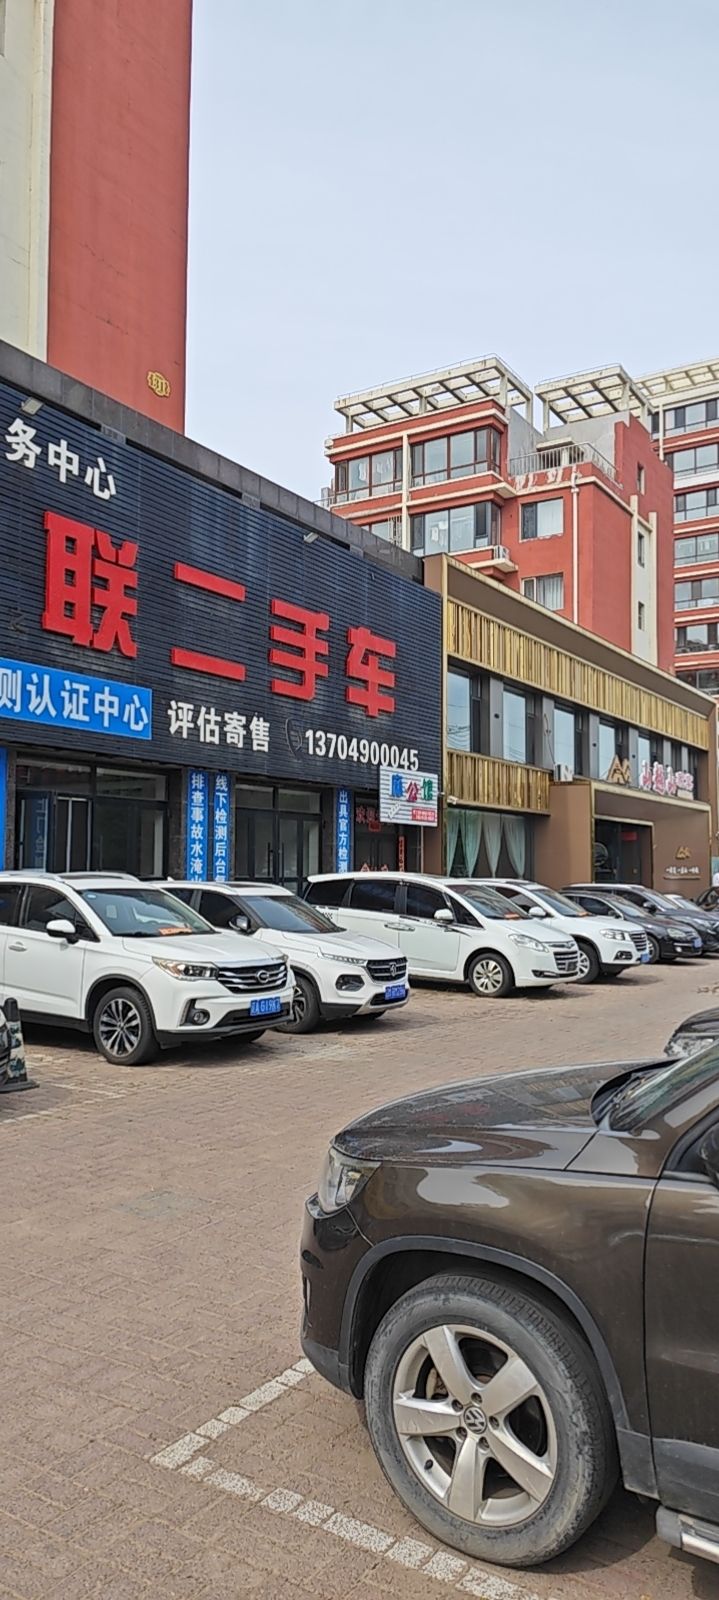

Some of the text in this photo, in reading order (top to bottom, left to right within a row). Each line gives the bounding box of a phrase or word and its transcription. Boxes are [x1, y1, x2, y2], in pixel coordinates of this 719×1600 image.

[5, 418, 117, 501] 务中心
[167, 700, 271, 753] 评估寄售
[305, 729, 419, 771] 13704900045
